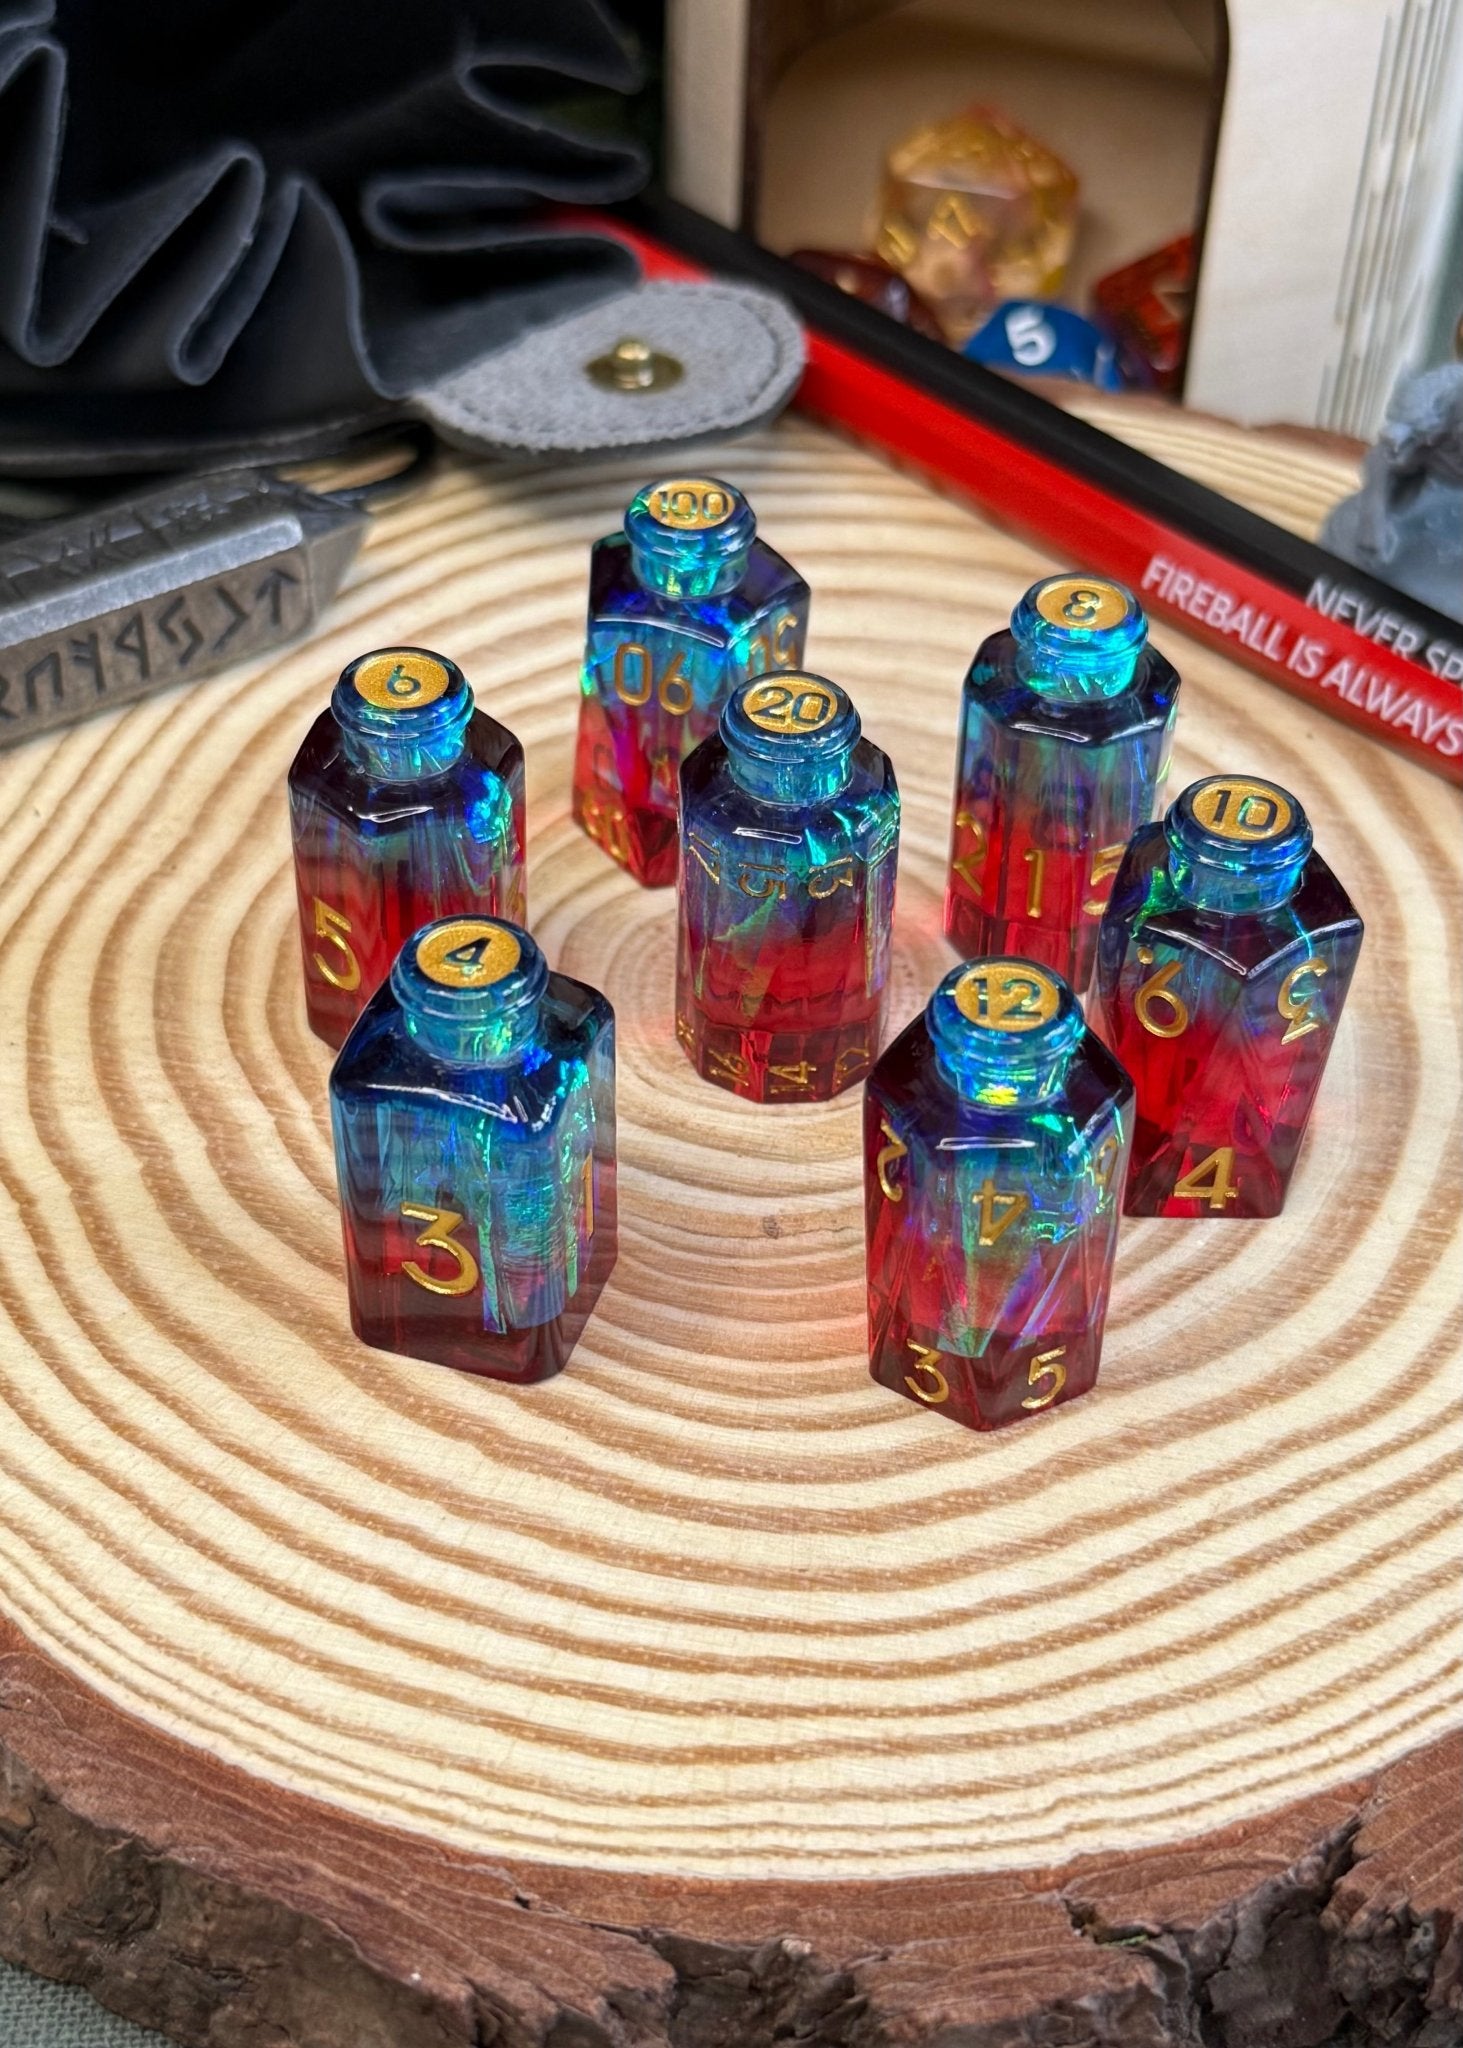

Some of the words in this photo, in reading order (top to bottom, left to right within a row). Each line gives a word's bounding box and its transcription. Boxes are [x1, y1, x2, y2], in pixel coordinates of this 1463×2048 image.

[1005, 304, 1057, 367] 5
[656, 489, 729, 520] 100
[1061, 590, 1100, 620] 8
[1305, 576, 1418, 664] NEVER
[385, 664, 422, 697] 6
[1141, 556, 1288, 663] FIREBALL
[1287, 634, 1325, 679] IS
[1319, 655, 1463, 757] ALWAYS
[750, 686, 831, 727] 20
[1205, 788, 1278, 833] 10
[953, 811, 988, 897] 2
[1024, 849, 1044, 919] 1
[312, 896, 362, 992] 5
[444, 937, 492, 977] 4
[970, 975, 1045, 1020] 12
[1174, 1146, 1239, 1210] 4
[972, 1179, 1029, 1248] 4
[401, 1201, 479, 1297] 3
[904, 1340, 950, 1404] 3
[1021, 1345, 1068, 1410] 5
